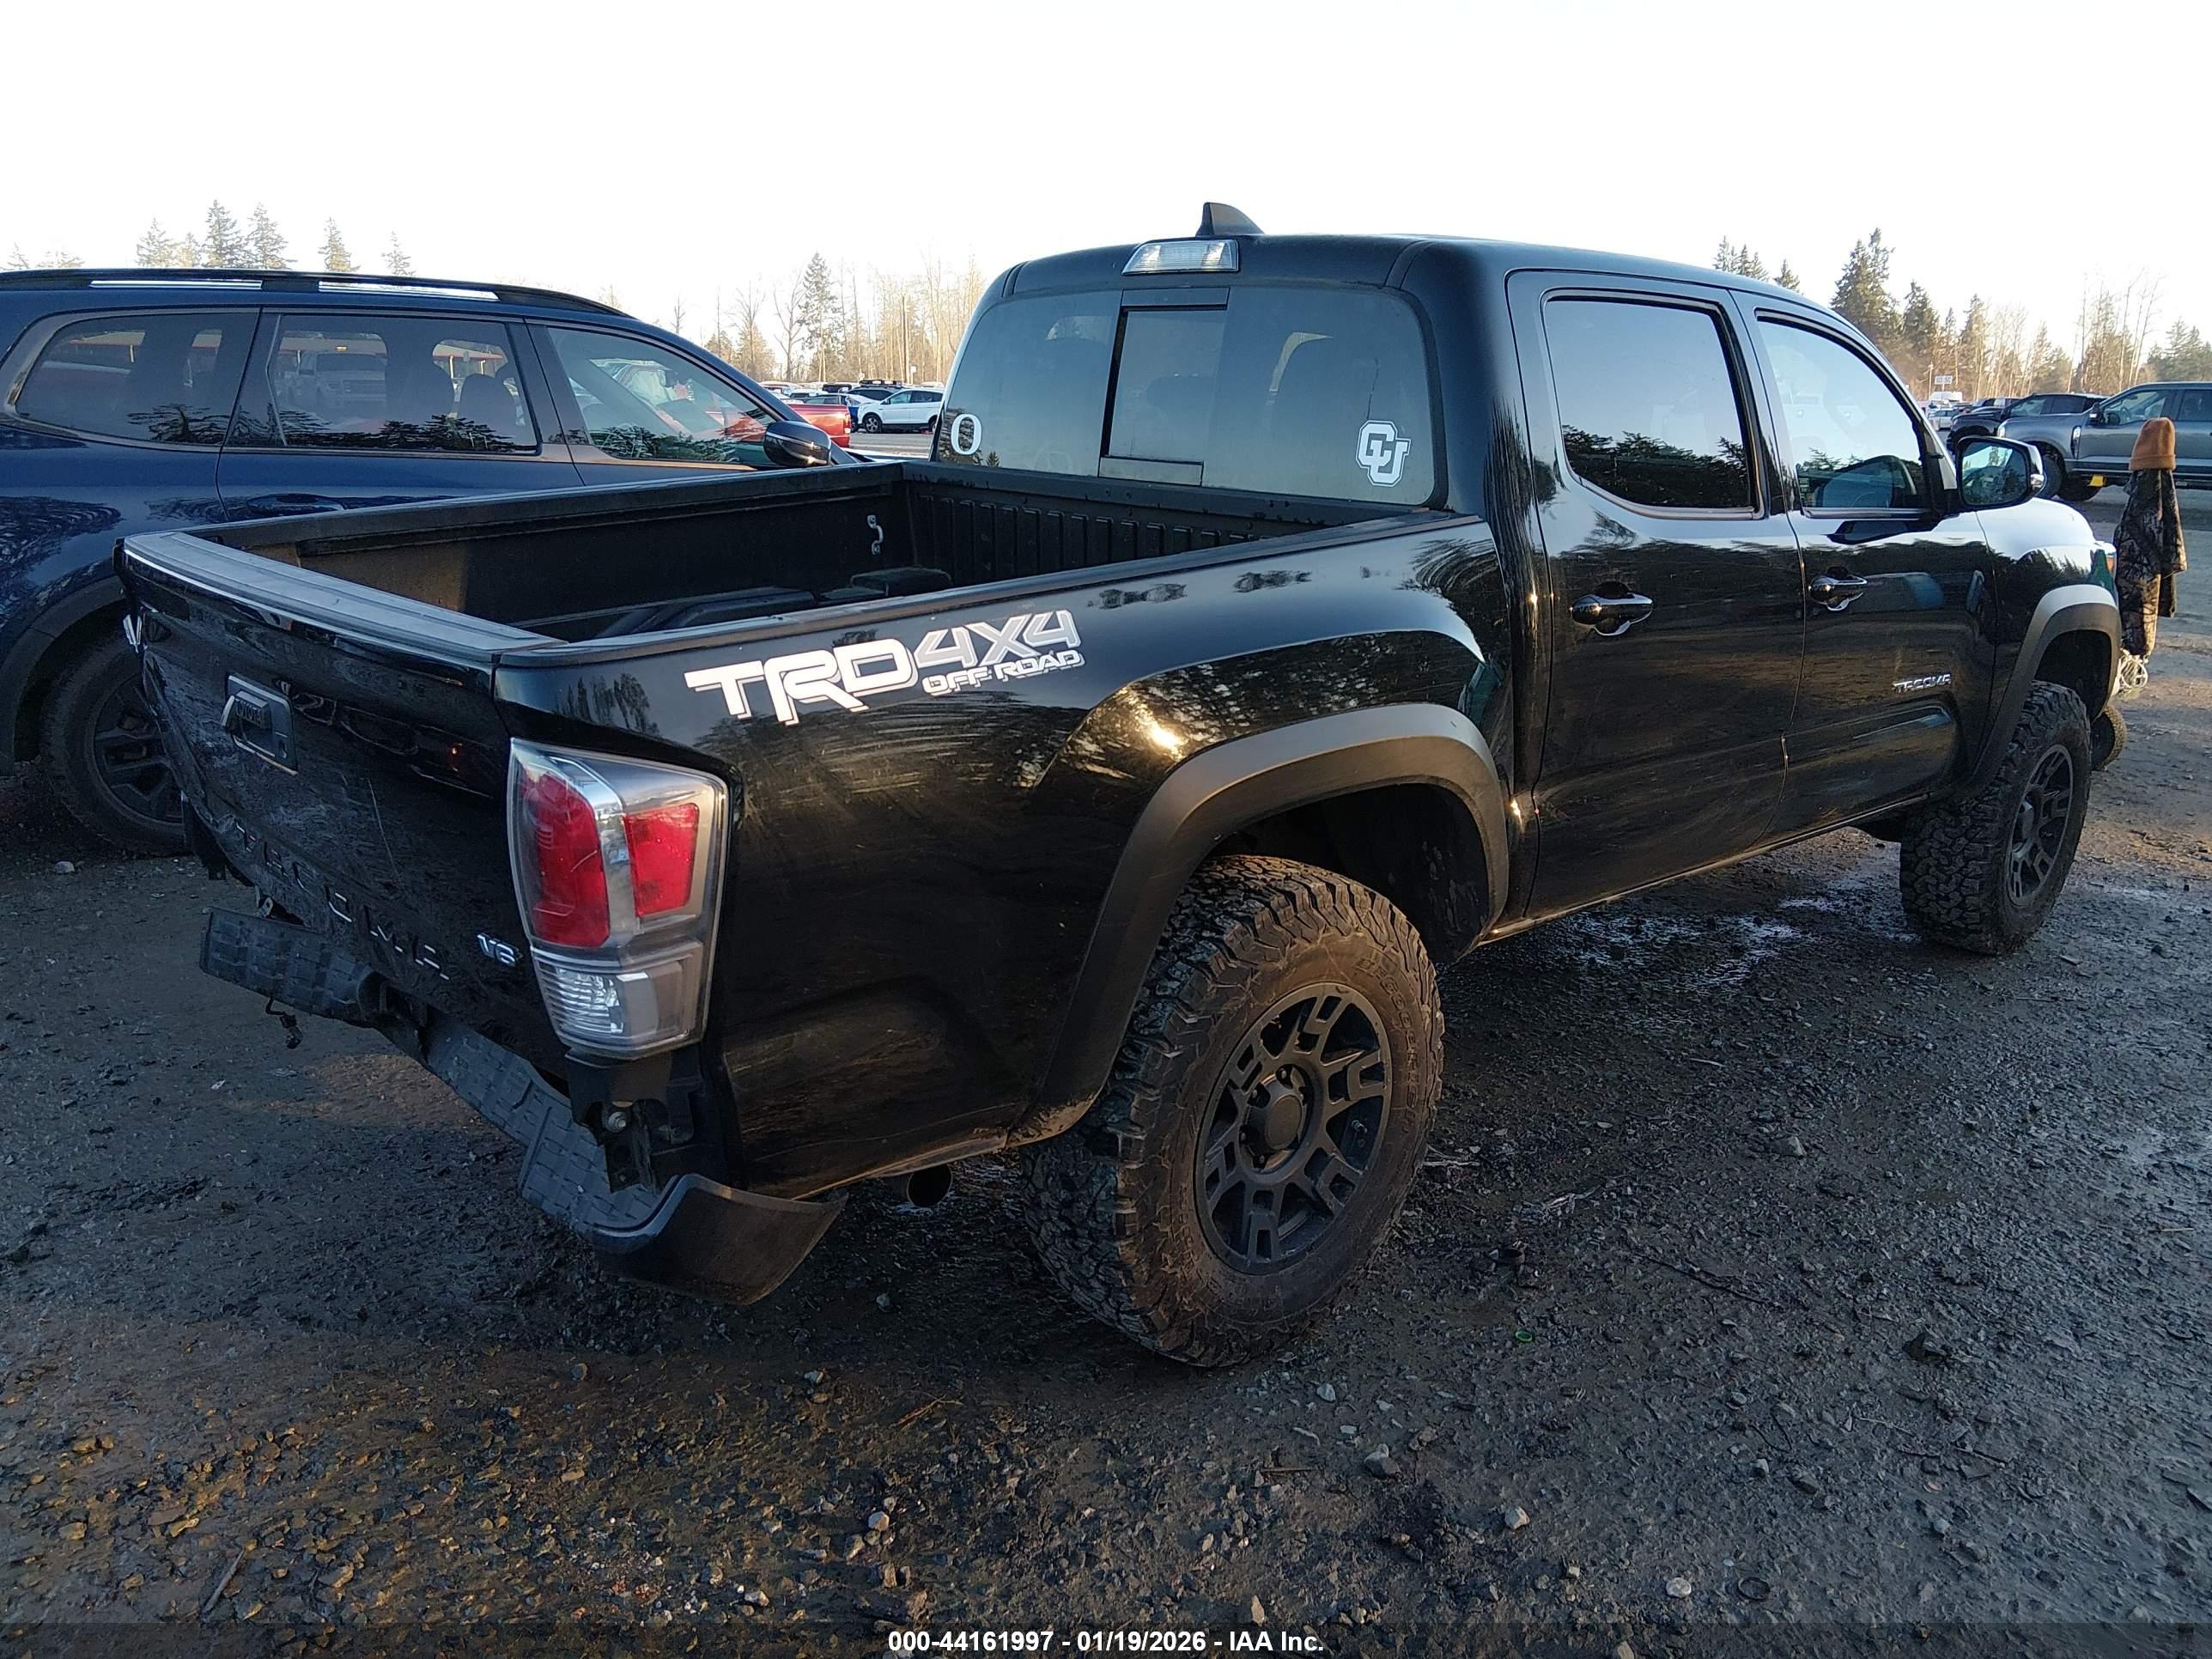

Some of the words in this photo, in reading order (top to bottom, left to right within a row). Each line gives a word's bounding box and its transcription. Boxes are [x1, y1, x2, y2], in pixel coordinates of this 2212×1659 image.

[951, 413, 981, 455] O
[1356, 420, 1411, 487] CU
[684, 638, 919, 726] TRD
[915, 609, 1082, 669] 4X4
[921, 665, 997, 697] OFF
[994, 649, 1086, 683] ROAD
[477, 933, 519, 967] V6
